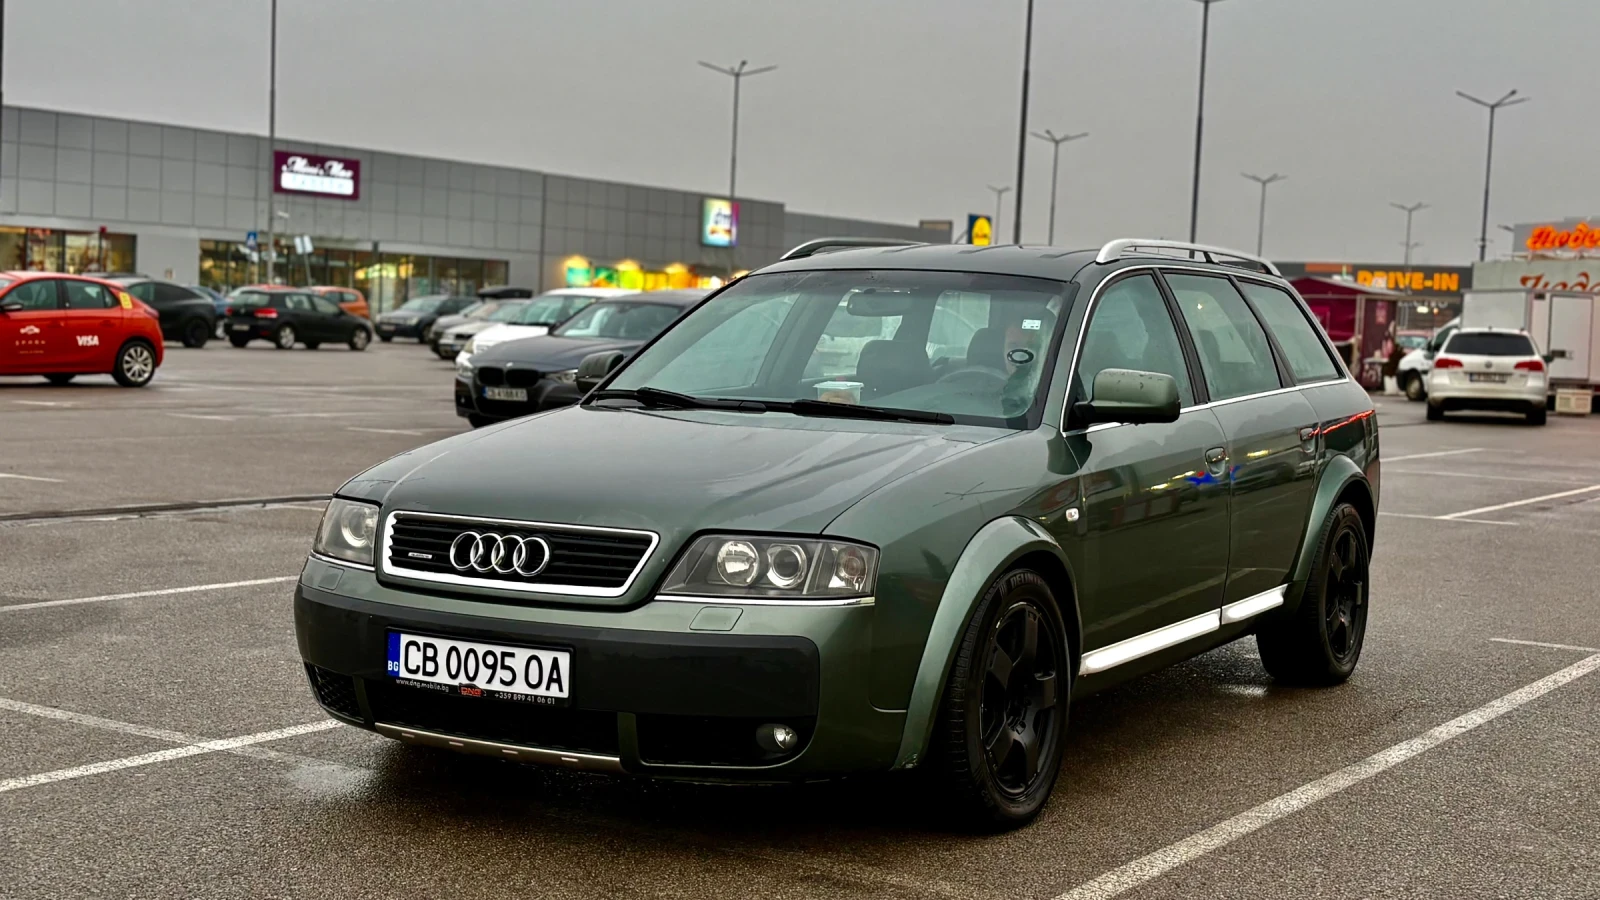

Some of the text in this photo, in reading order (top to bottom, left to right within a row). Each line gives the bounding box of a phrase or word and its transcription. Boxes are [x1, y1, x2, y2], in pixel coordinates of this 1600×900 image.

[76, 335, 99, 347] VISA
[387, 660, 399, 672] BG
[404, 640, 564, 693] CB 0095 OA
[396, 679, 449, 692] www.dng.mobile.bg
[460, 686, 482, 695] DNG
[495, 692, 555, 705] +359 899 41 06 01
